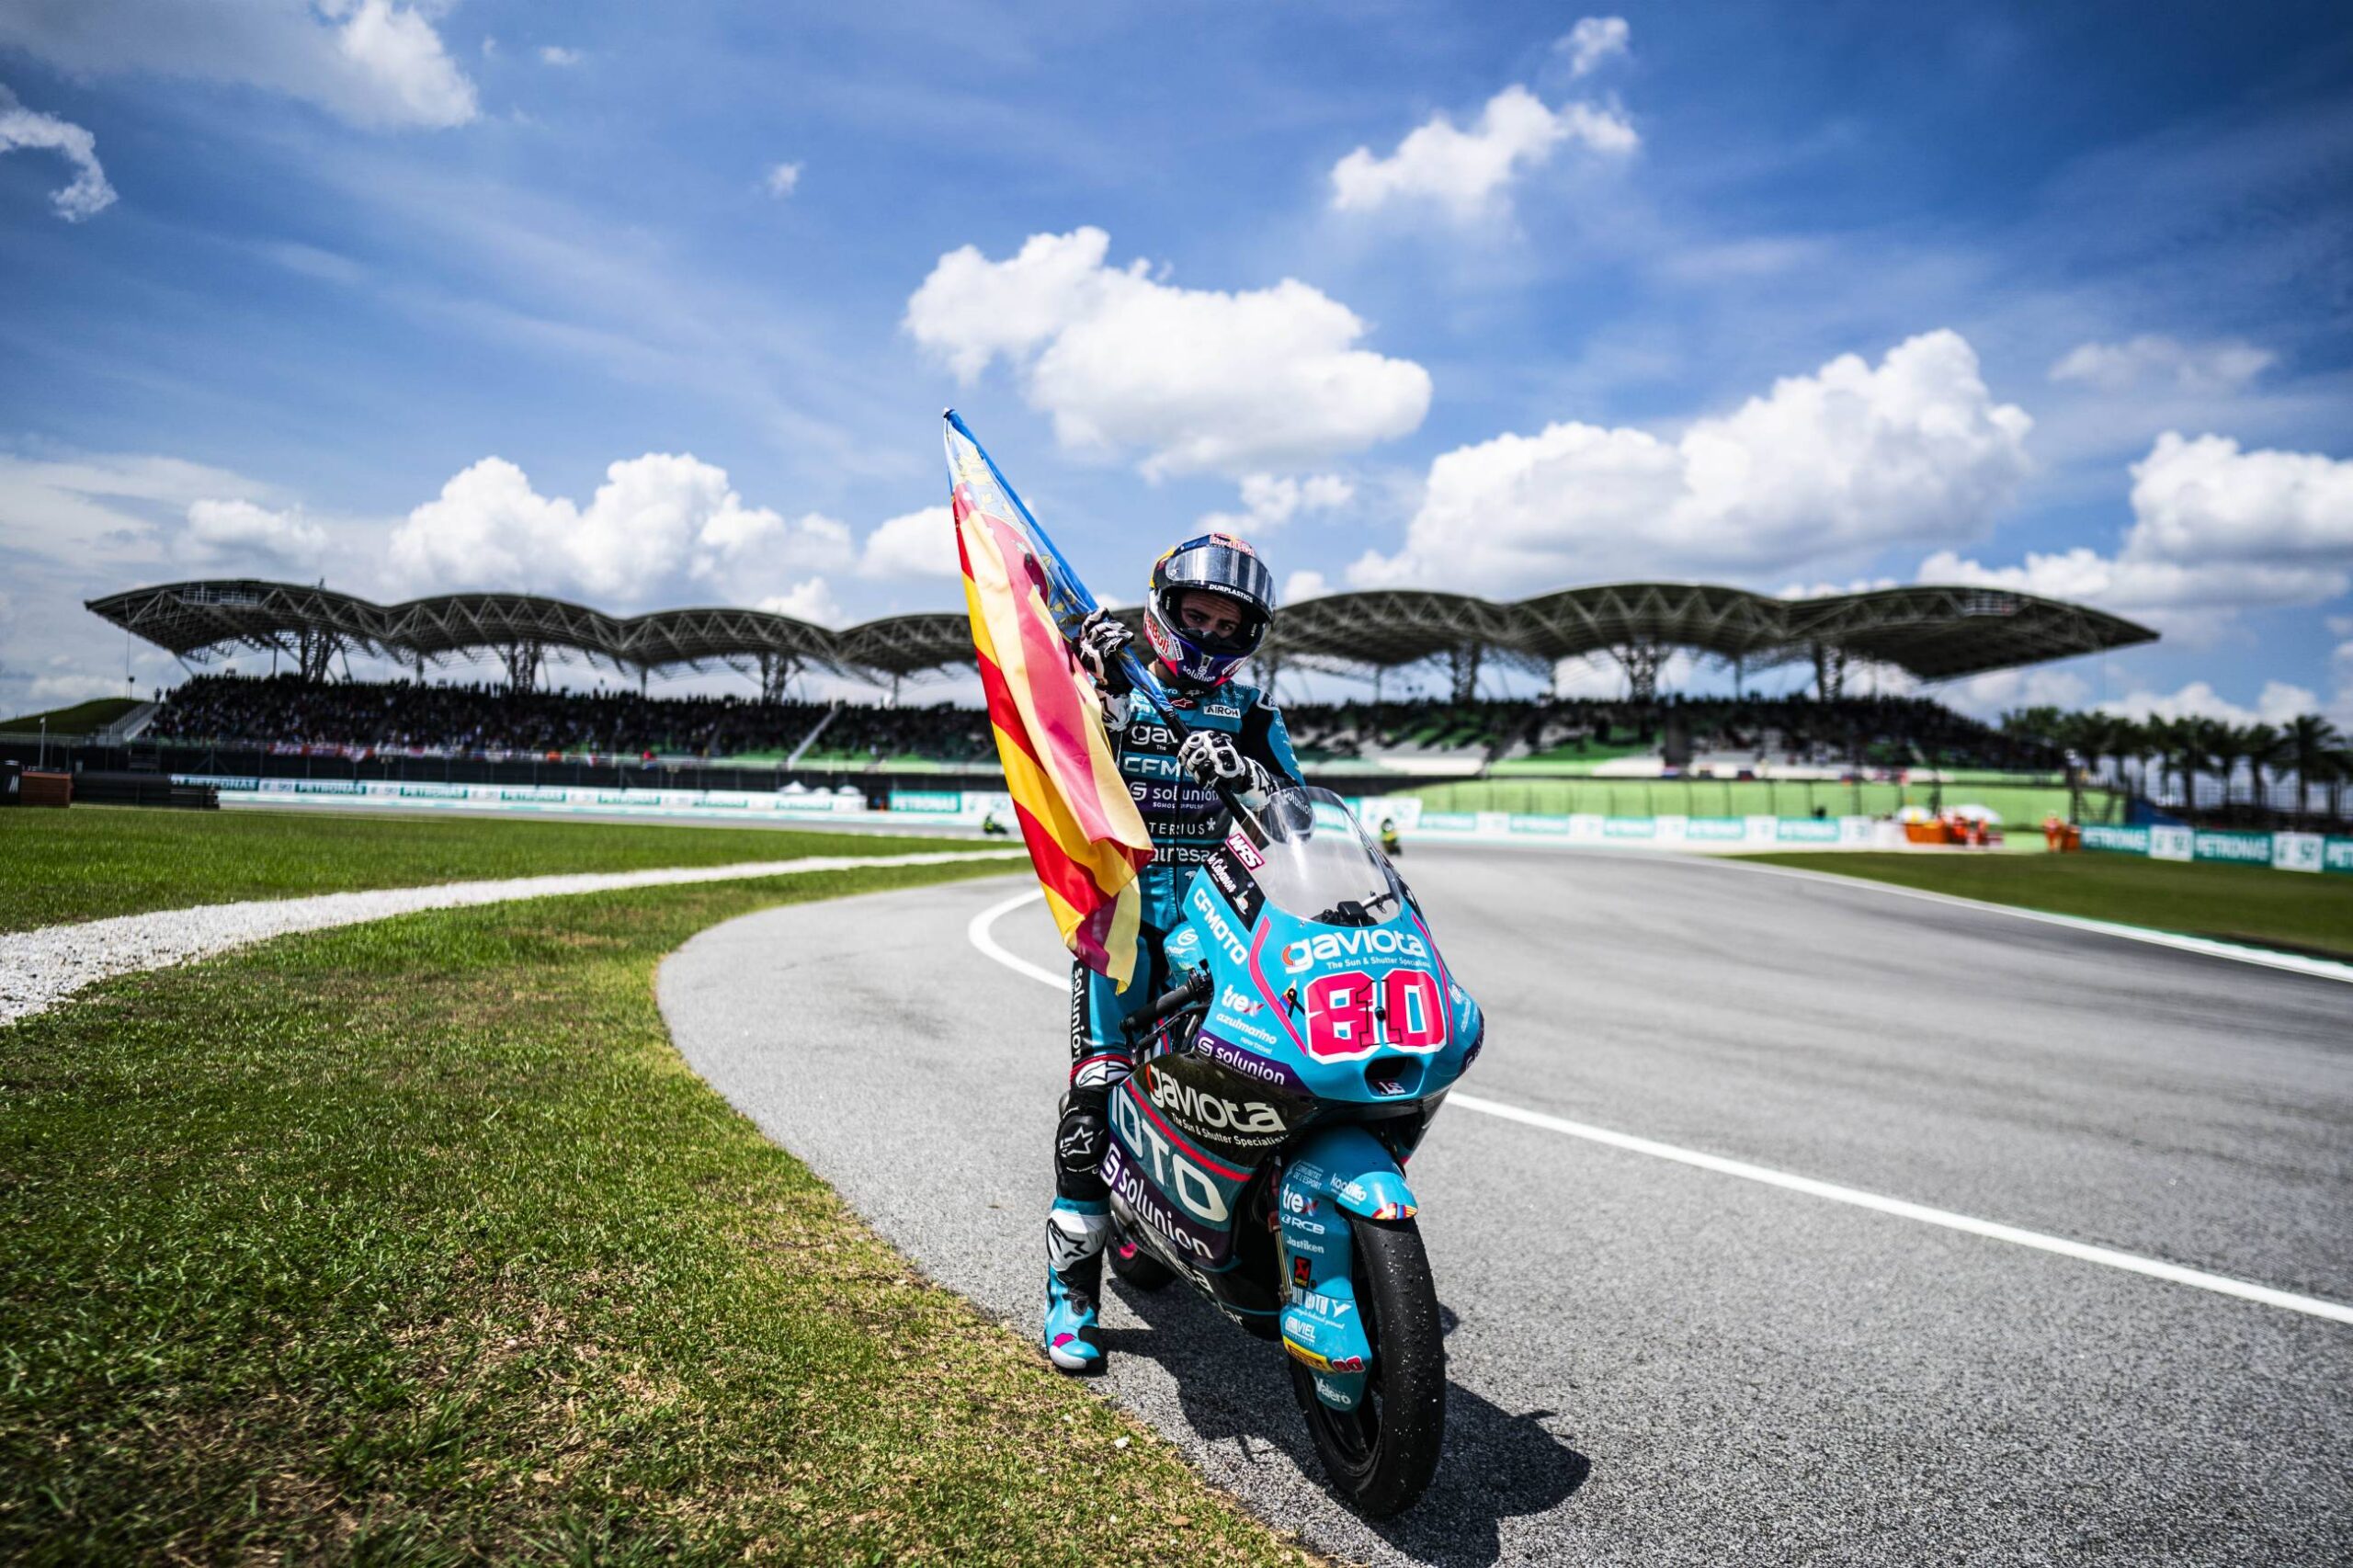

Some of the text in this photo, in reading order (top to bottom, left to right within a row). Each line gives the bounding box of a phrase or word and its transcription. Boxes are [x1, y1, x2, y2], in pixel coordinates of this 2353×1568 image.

[1209, 584, 1254, 604] DURPLASTICS
[1182, 665, 1216, 683] solunion
[1206, 705, 1239, 718] AIROH
[1123, 756, 1183, 778] CFM
[1152, 785, 1219, 801] solunion
[1151, 847, 1211, 863] alresa
[1229, 835, 1263, 867] WRS
[1211, 858, 1237, 893] Cabanon
[1194, 888, 1248, 965] CFMOTO
[1281, 928, 1428, 974] gaviota
[1326, 961, 1343, 971] The
[1345, 958, 1361, 967] Sun
[1371, 957, 1397, 965] Shutter
[1222, 983, 1265, 1017] trex
[1216, 1013, 1278, 1045] azulmarino
[1303, 968, 1447, 1065] 80
[1215, 1047, 1285, 1085] solunion
[1145, 1062, 1287, 1133] gaviota
[1171, 1112, 1182, 1127] The
[1182, 1119, 1195, 1133] Sun
[1202, 1128, 1232, 1144] Shutter
[1111, 1085, 1229, 1222] OTO
[1118, 1167, 1214, 1259] solunion
[1282, 1183, 1319, 1217] trex
[1291, 1218, 1325, 1235] RCB
